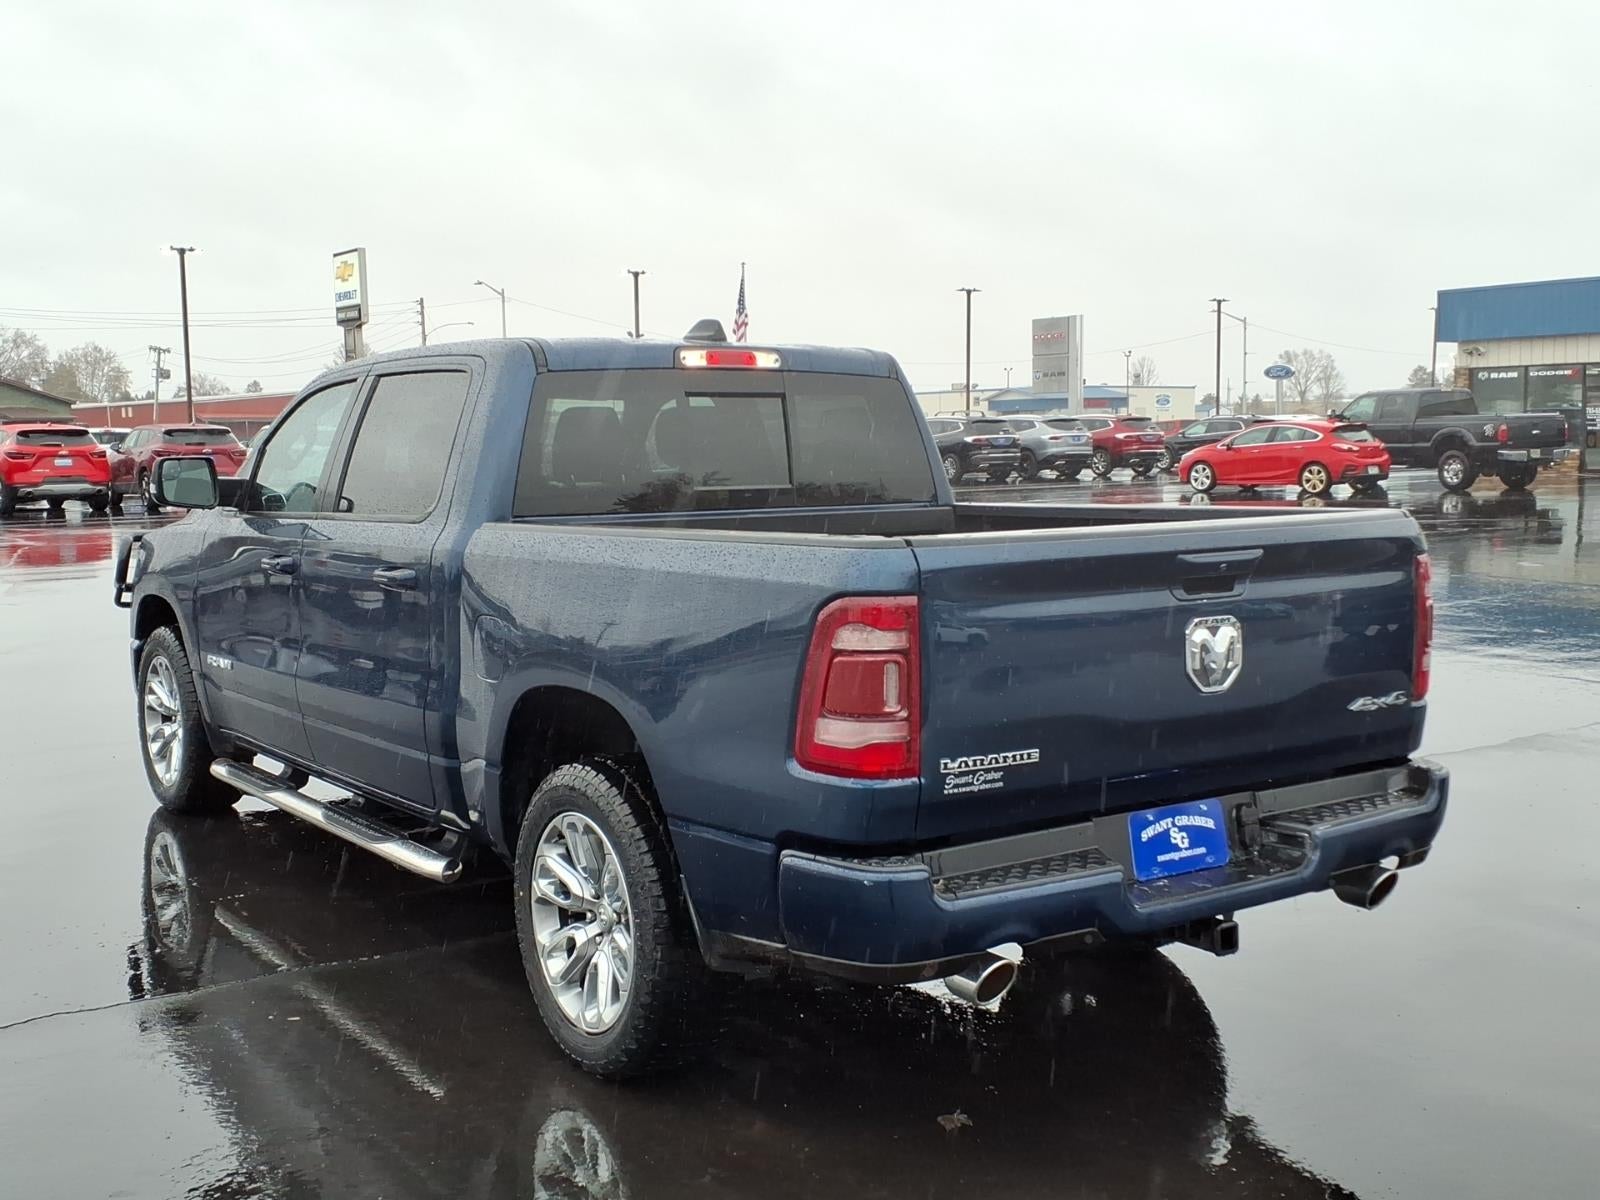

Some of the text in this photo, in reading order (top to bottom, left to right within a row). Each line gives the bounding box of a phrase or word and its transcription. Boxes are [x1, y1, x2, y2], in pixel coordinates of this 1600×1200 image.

[1490, 371, 1519, 379] RAM
[1529, 369, 1573, 377] DODGE
[207, 654, 234, 670] RAM
[940, 748, 1040, 773] LARAMIE
[973, 771, 1004, 785] Graber
[1140, 815, 1217, 842] SWANT GRABER
[1169, 826, 1190, 849] SG
